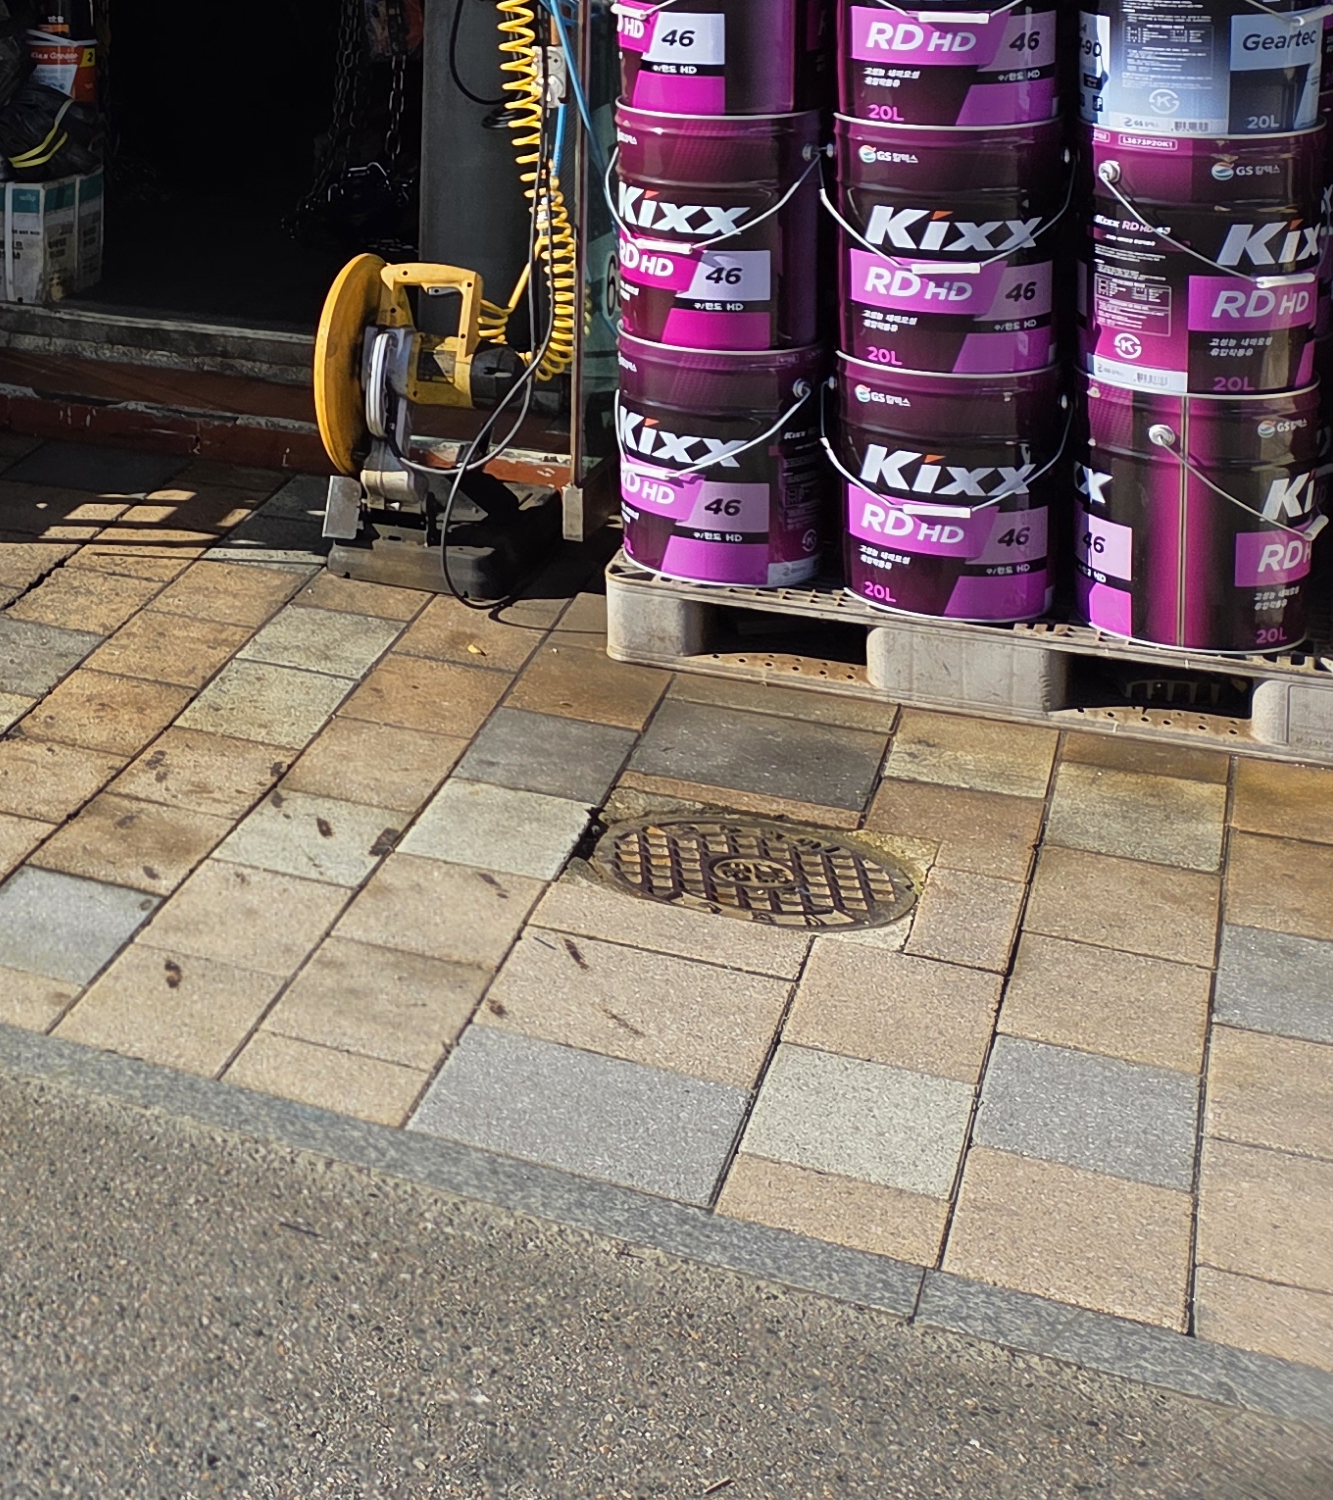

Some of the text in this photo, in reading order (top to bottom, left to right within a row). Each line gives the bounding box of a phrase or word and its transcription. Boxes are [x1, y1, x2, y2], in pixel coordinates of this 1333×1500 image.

[624, 18, 696, 47] HD 46
[865, 21, 1041, 52] RD HD 46
[1242, 30, 1318, 52] Geartec
[679, 65, 698, 75] HD
[867, 104, 905, 122] 20L
[1247, 114, 1280, 129] 20L
[618, 181, 751, 236] Kixx
[864, 204, 1043, 252] Kixx
[1121, 220, 1140, 231] RD
[1216, 218, 1321, 266] Kix
[639, 254, 674, 277] HD
[705, 266, 743, 285] 46
[864, 266, 1037, 302] RD HD 46
[726, 302, 744, 312] HD
[1211, 290, 1309, 319] RD HD
[866, 345, 903, 366] 20L
[1213, 376, 1256, 392] 20L
[619, 405, 749, 468] Kixx
[860, 443, 1037, 496] Kixx
[641, 483, 676, 506] HD
[704, 498, 742, 516] 46
[1259, 469, 1316, 522] Ki
[725, 532, 743, 543] HD
[860, 502, 1031, 547] RD HD 46
[1082, 531, 1107, 554] 46
[1257, 540, 1303, 573] RD
[864, 581, 897, 603] 20L
[1256, 627, 1288, 644] 20L
